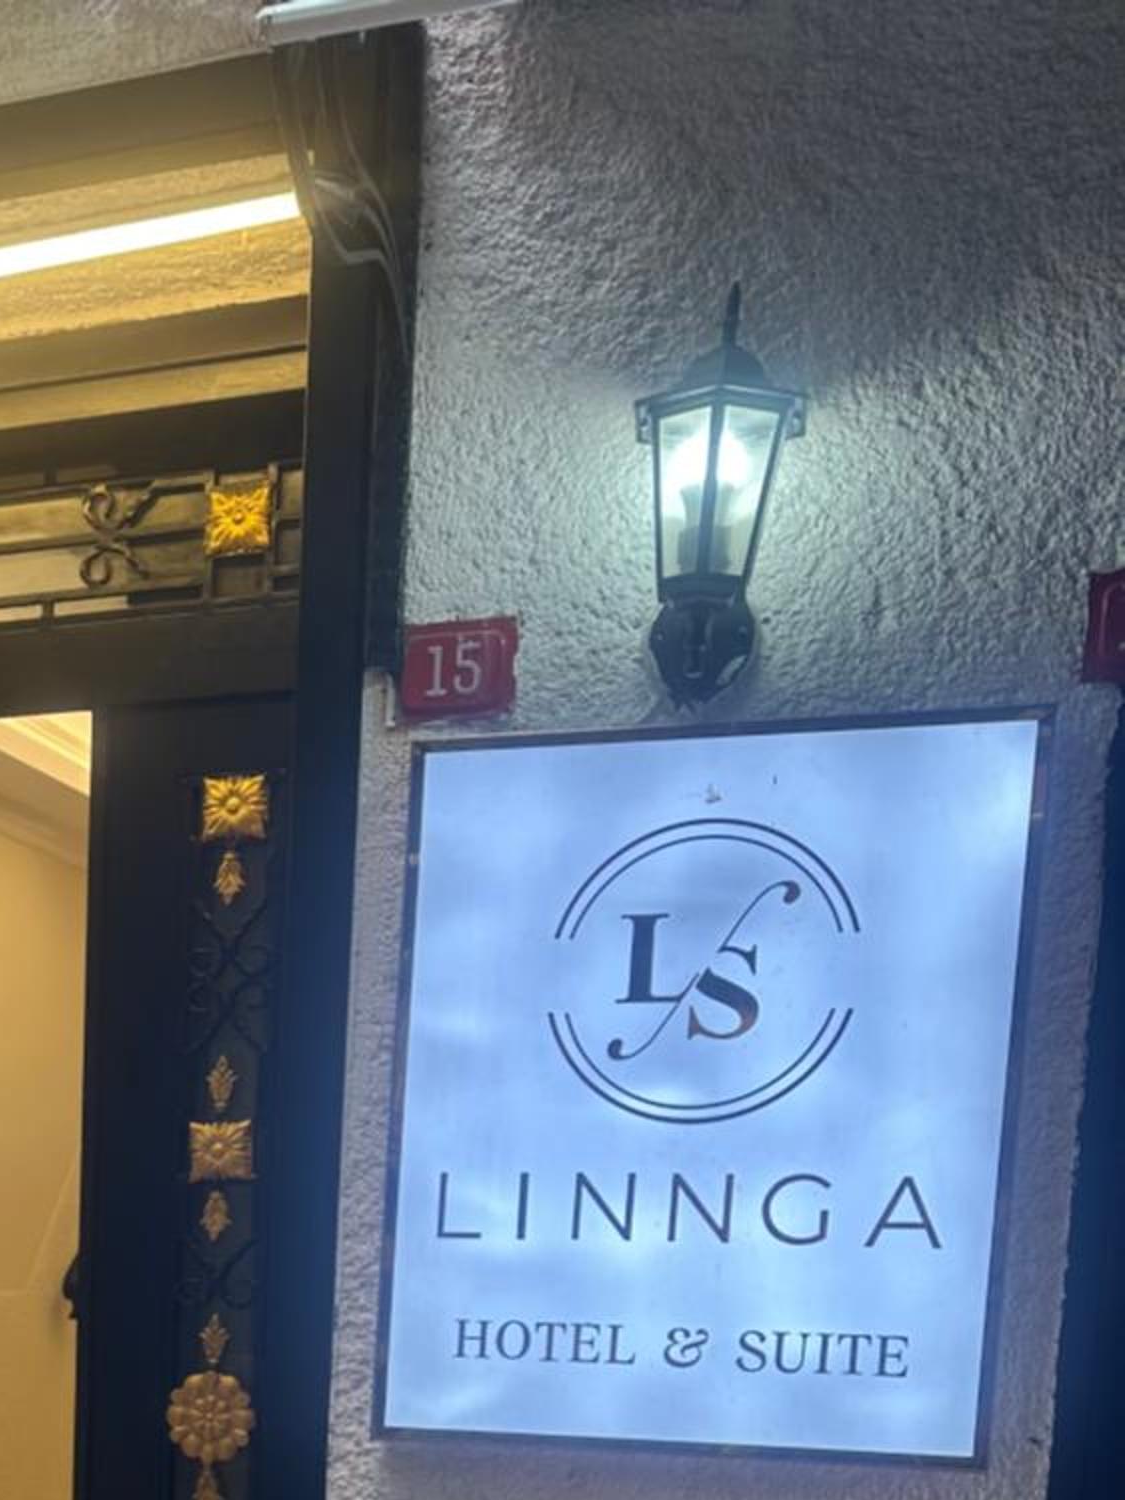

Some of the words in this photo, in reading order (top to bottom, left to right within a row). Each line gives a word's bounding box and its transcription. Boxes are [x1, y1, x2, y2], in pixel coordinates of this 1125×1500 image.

[423, 642, 482, 699] 15
[435, 1171, 943, 1249] LINNGA
[452, 1318, 637, 1366] HOTEL
[663, 1327, 711, 1369] &
[735, 1329, 911, 1379] SUITE
